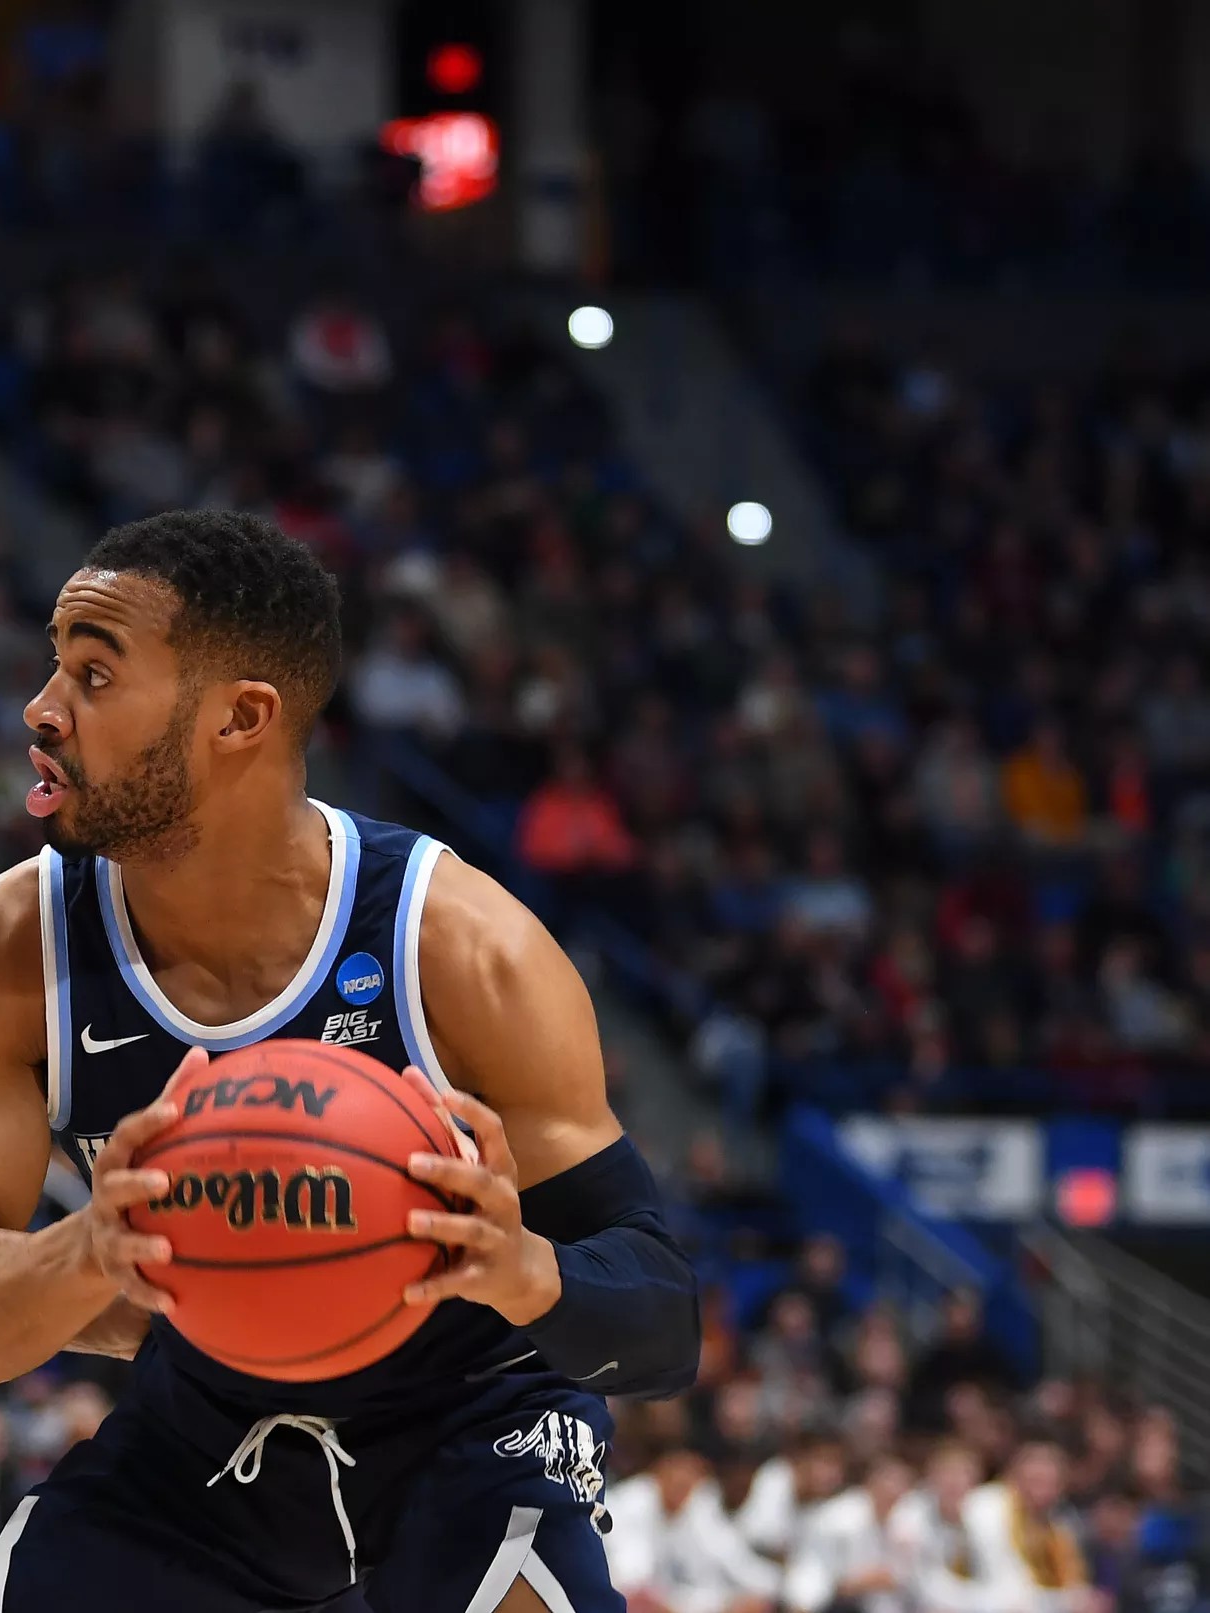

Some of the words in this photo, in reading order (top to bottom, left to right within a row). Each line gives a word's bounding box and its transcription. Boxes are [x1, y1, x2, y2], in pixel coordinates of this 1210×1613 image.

[343, 973, 381, 995] NCAA
[323, 1009, 369, 1031] BIG
[320, 1020, 382, 1044] EAST
[183, 1075, 338, 1119] NCAA
